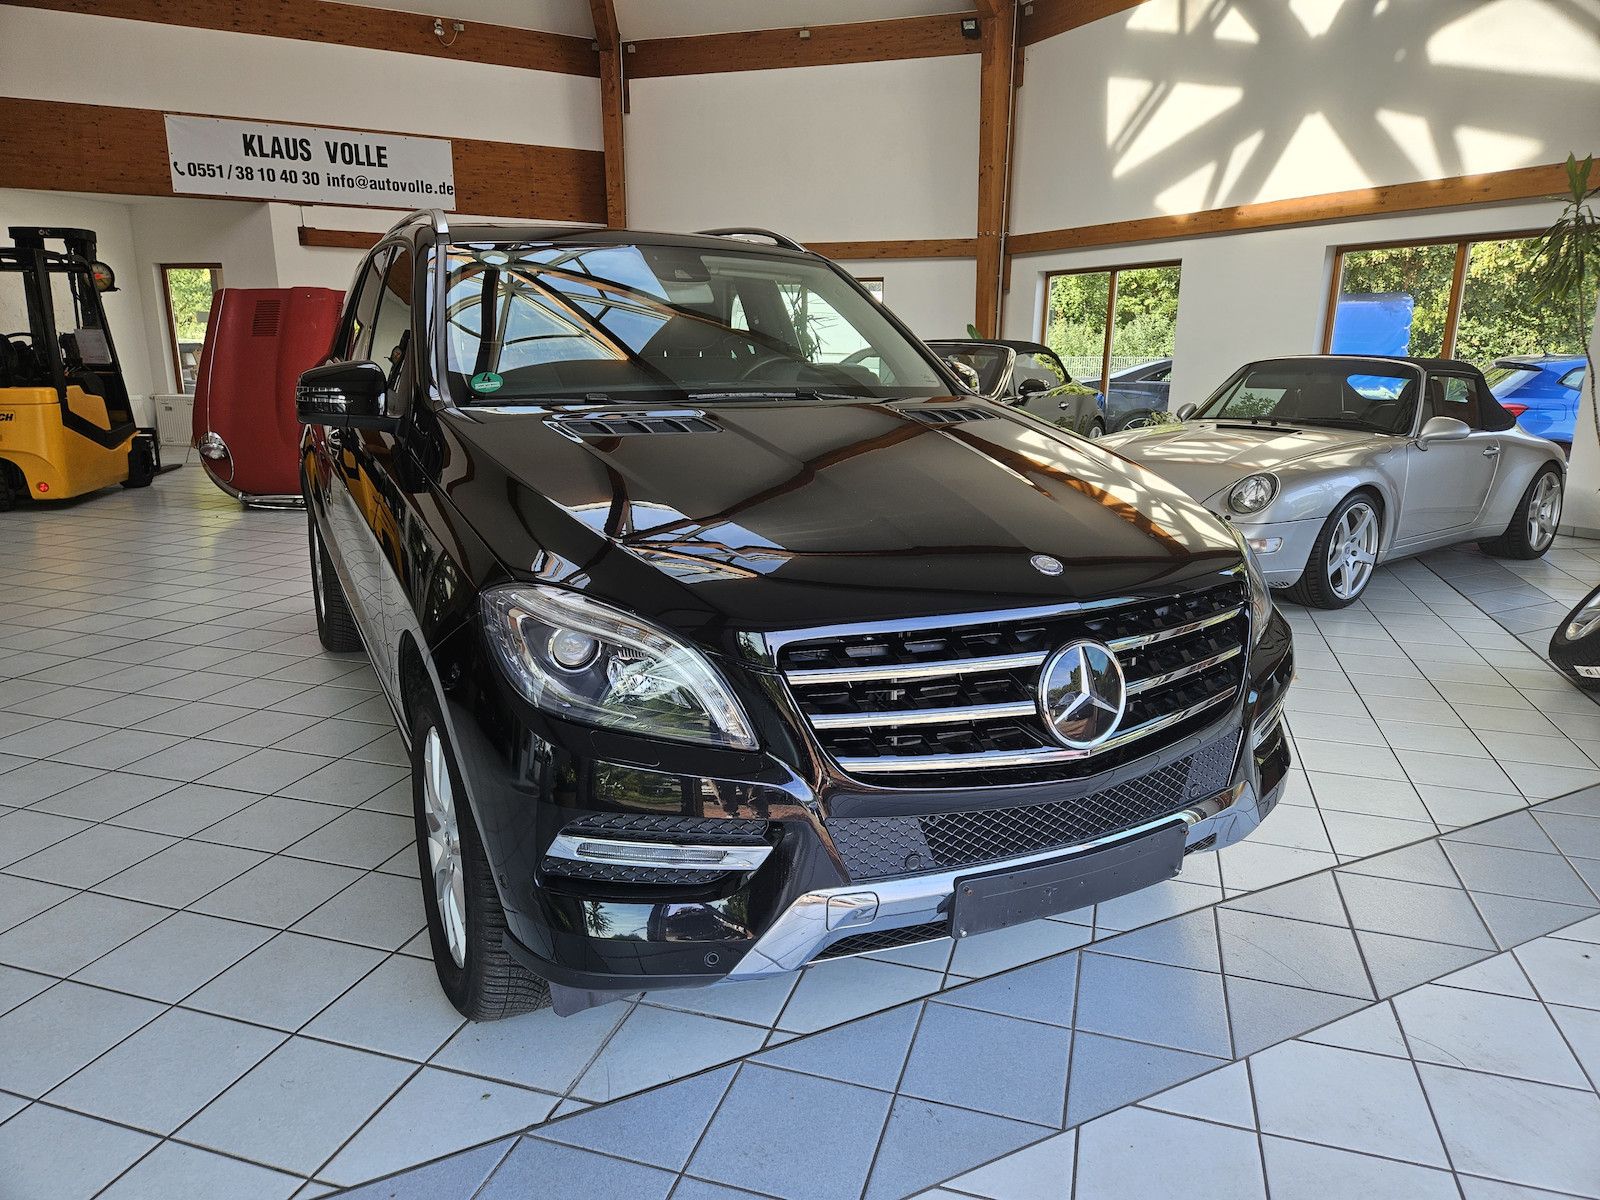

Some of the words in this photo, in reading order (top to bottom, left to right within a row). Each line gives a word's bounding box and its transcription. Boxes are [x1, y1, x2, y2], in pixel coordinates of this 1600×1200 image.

[242, 133, 312, 162] KLAUS
[324, 140, 388, 168] VOLLE
[257, 167, 276, 182] 10
[279, 169, 298, 184] 40
[302, 170, 320, 186] 30
[326, 172, 454, 196] info@autovolle.de
[482, 373, 492, 382] 4
